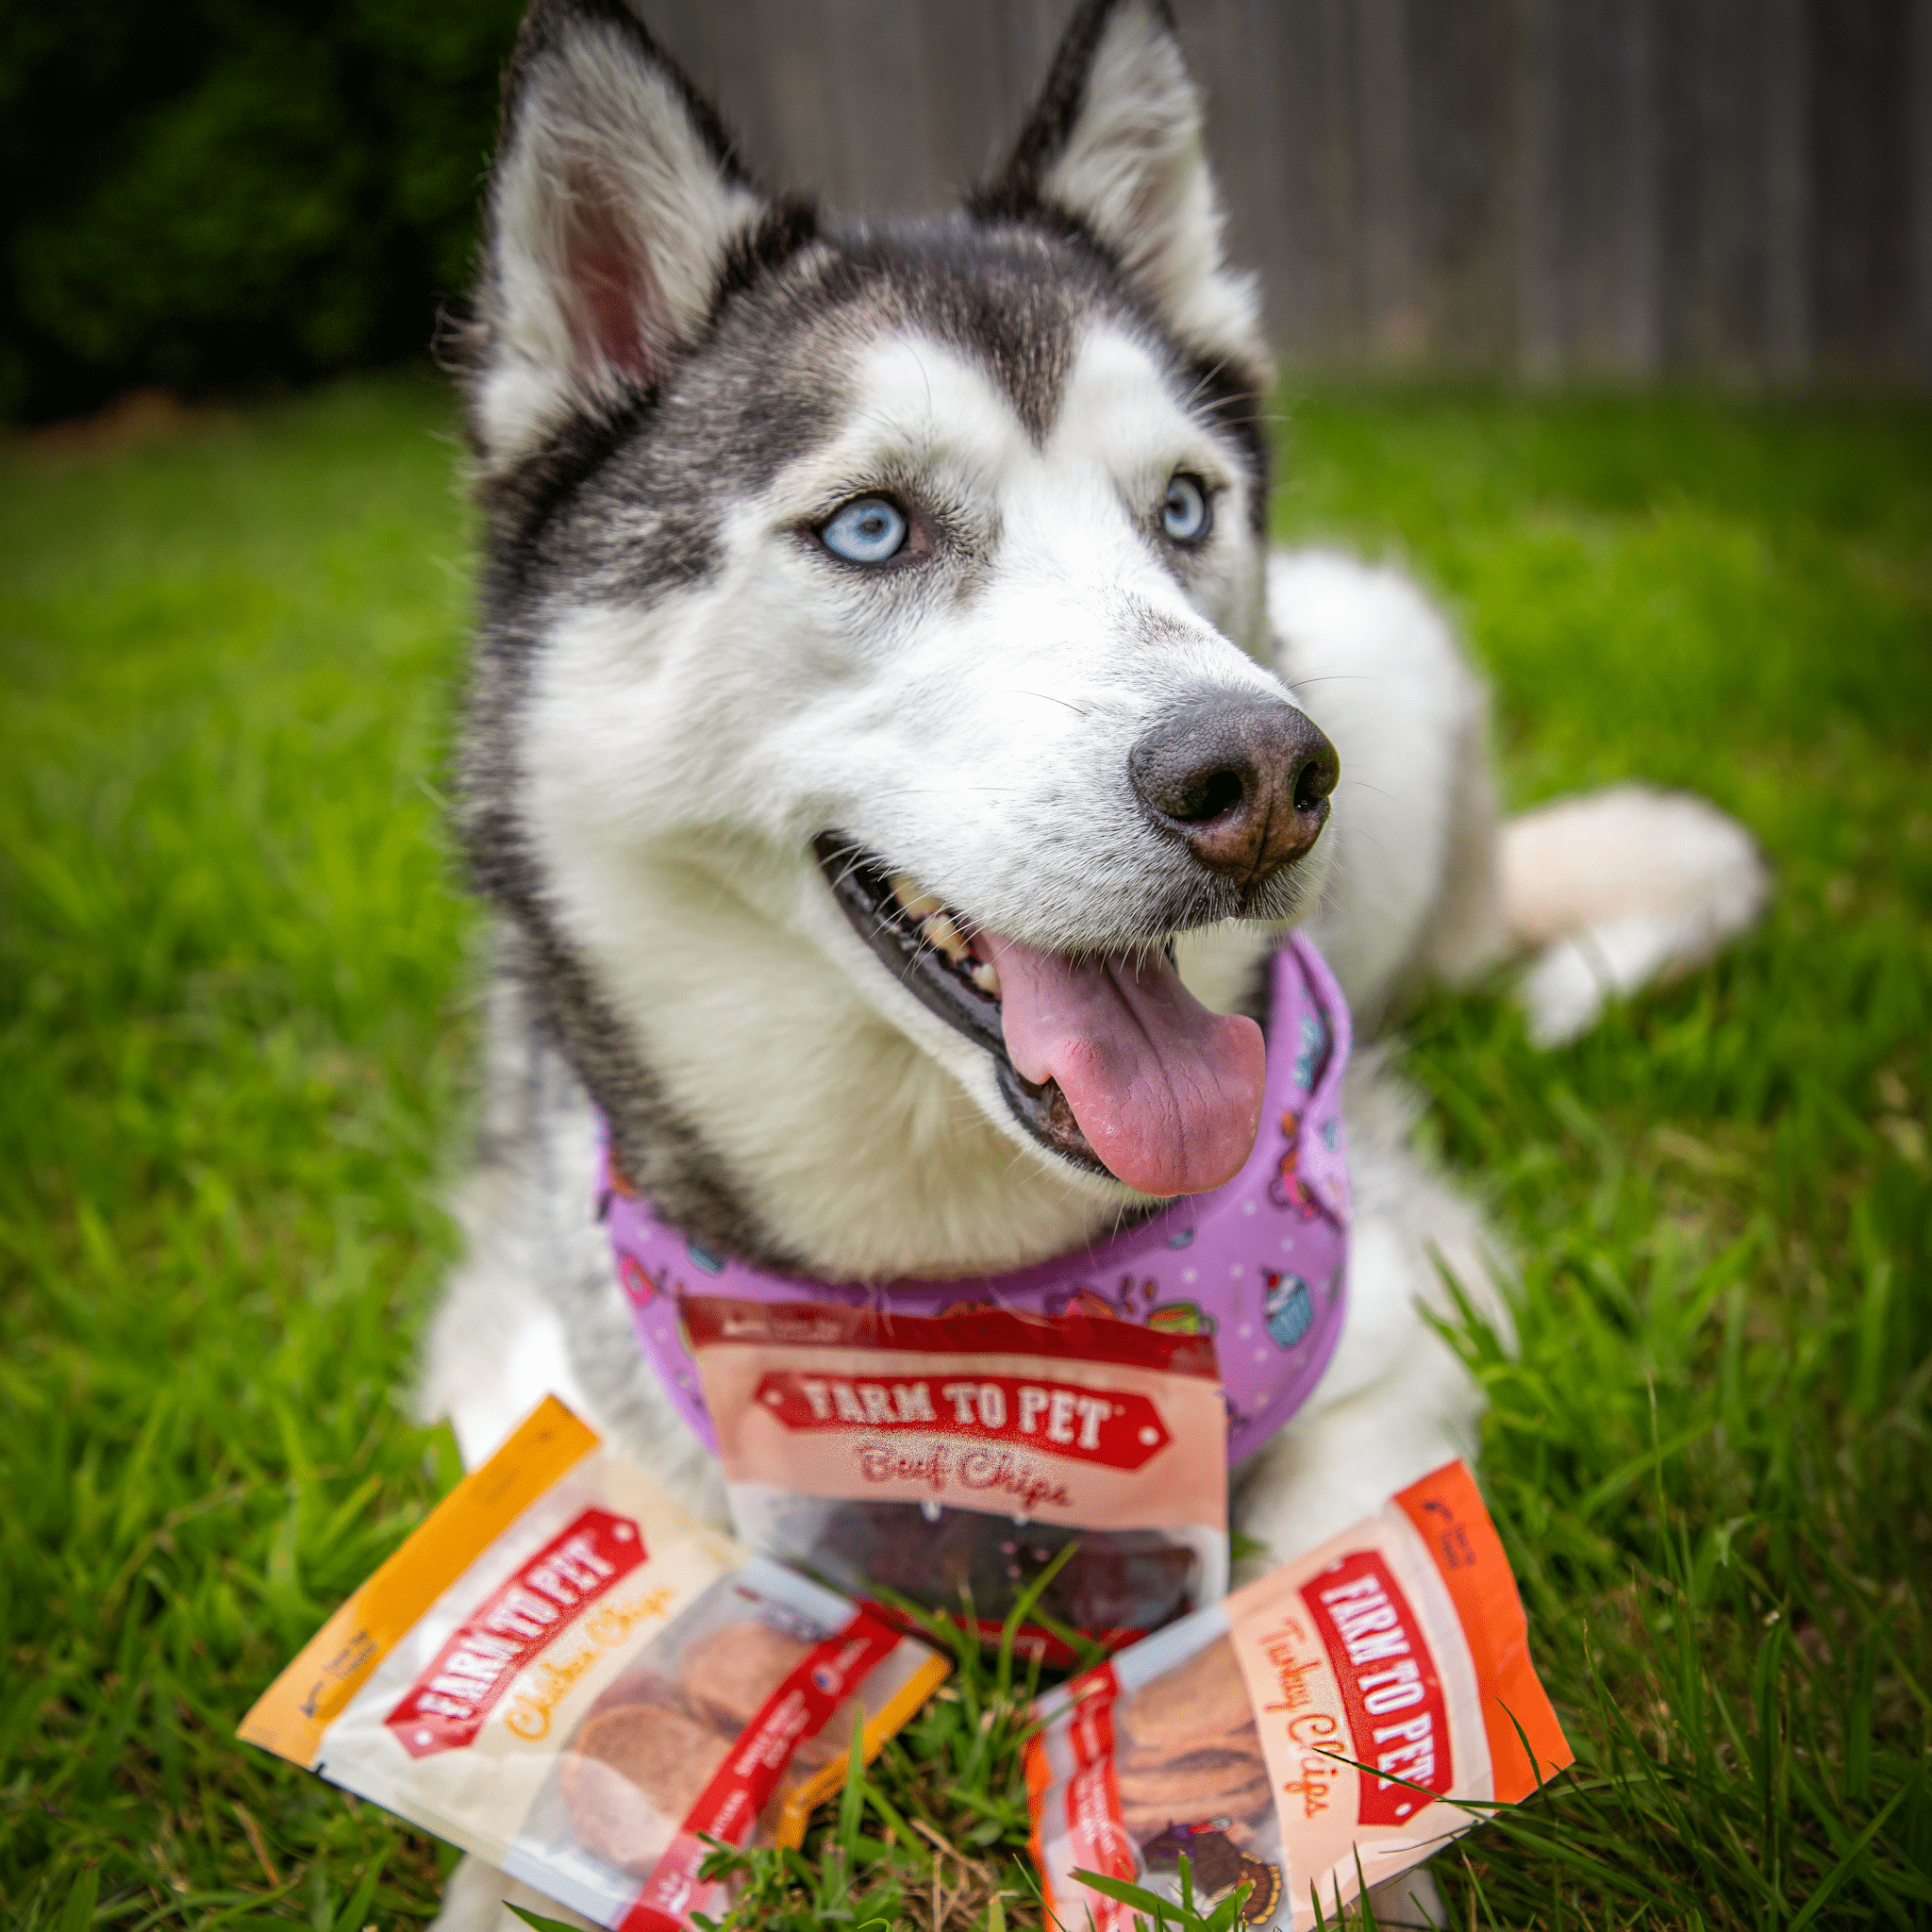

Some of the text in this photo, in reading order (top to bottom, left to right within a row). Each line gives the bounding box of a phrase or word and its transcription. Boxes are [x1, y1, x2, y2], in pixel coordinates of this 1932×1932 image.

[804, 1381, 1114, 1450] FARM TO PET
[855, 1444, 1074, 1511] Beef Chips
[416, 1631, 525, 1720] FARM
[485, 1589, 560, 1639] TO
[525, 1538, 615, 1606] PET
[1257, 1617, 1345, 1820] Turkey Chips
[1320, 1574, 1436, 1791] FARM TO PET
